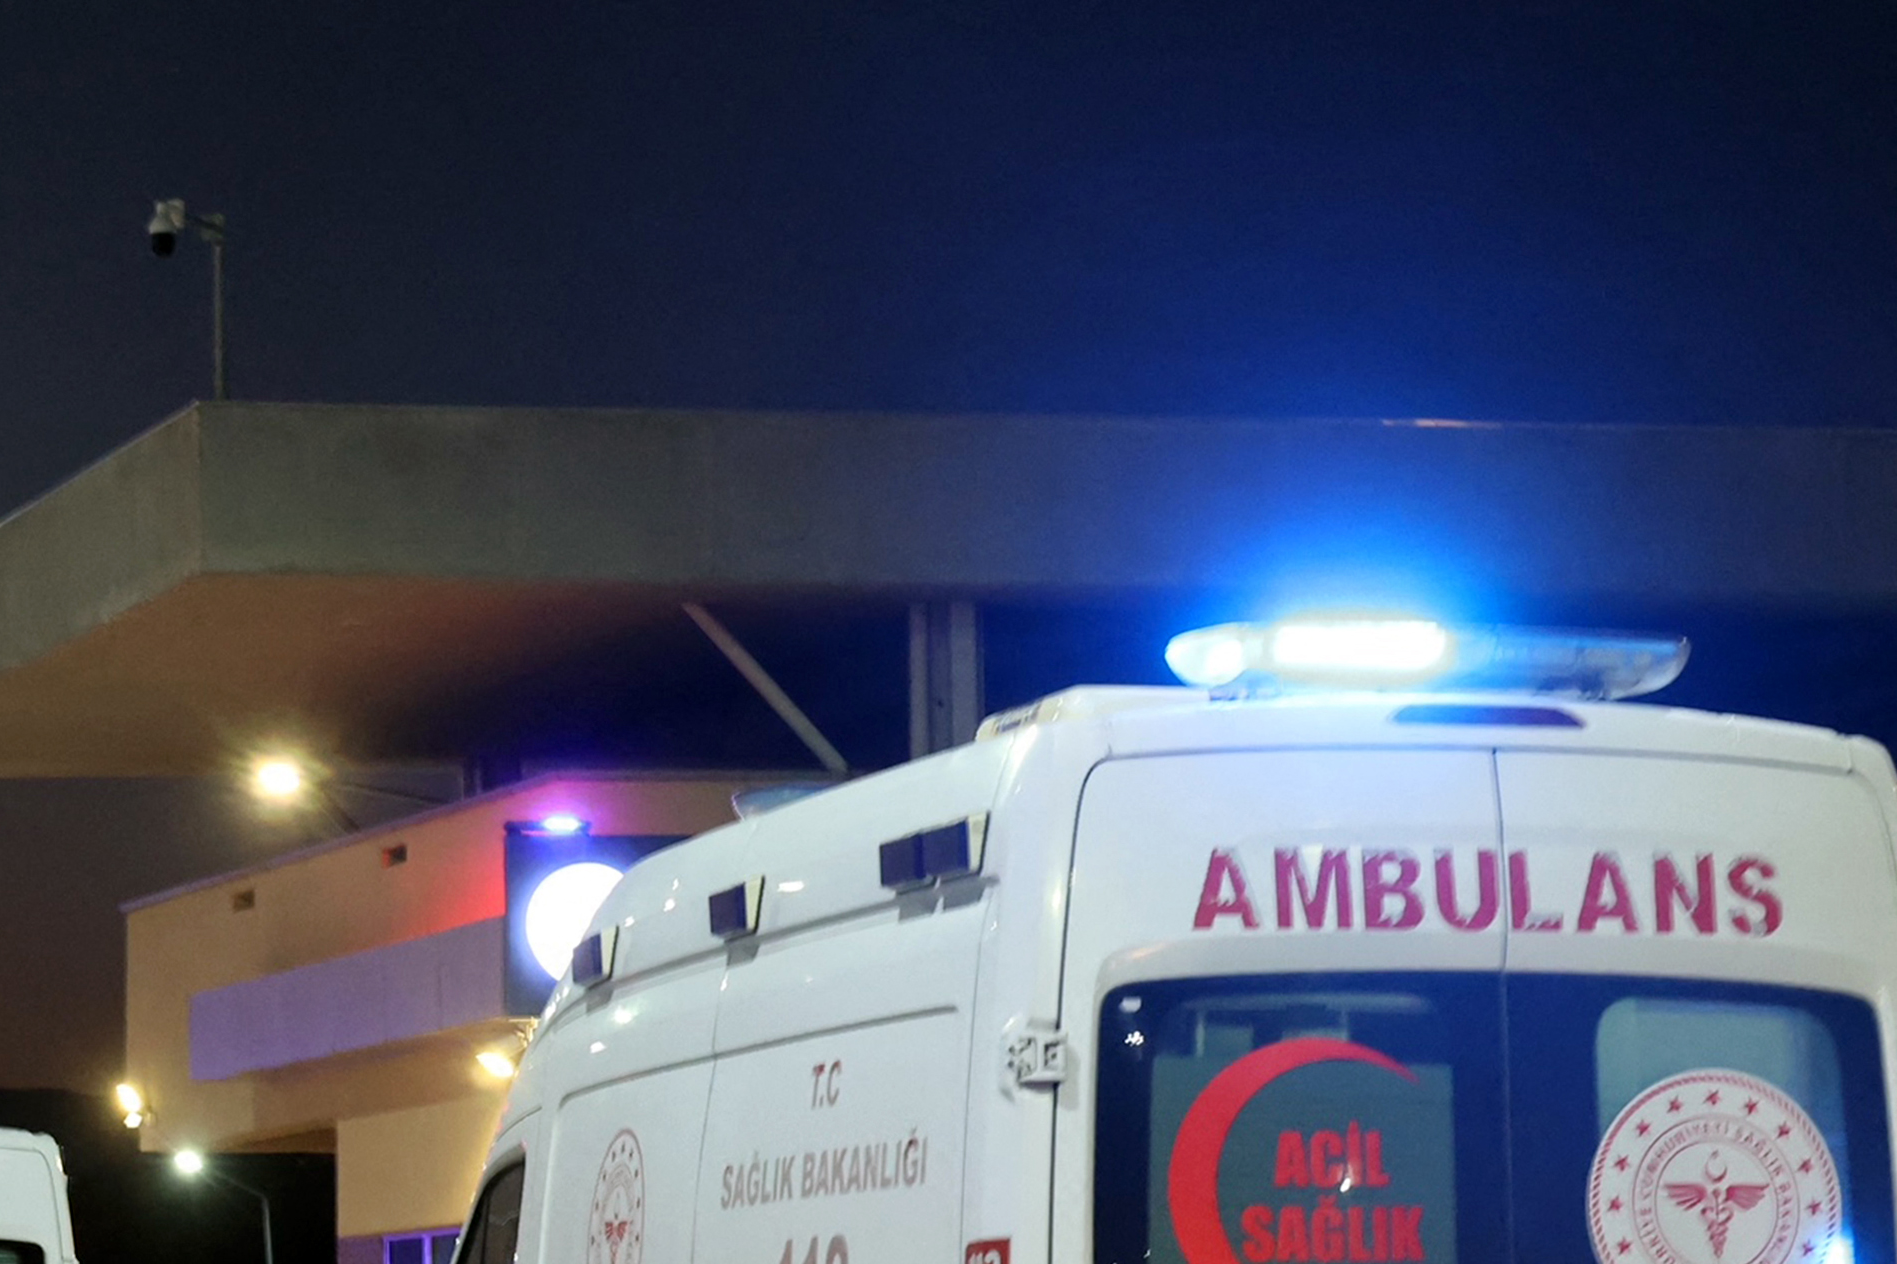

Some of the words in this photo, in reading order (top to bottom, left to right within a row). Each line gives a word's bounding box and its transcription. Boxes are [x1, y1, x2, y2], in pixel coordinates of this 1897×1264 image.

[1192, 847, 1784, 938] AMBULANS
[720, 1150, 796, 1210] SAĞLIK
[800, 1126, 929, 1199] BAKANLIĞI
[1274, 1119, 1391, 1188] ACİL
[1240, 1195, 1426, 1264] SAĞLIK
